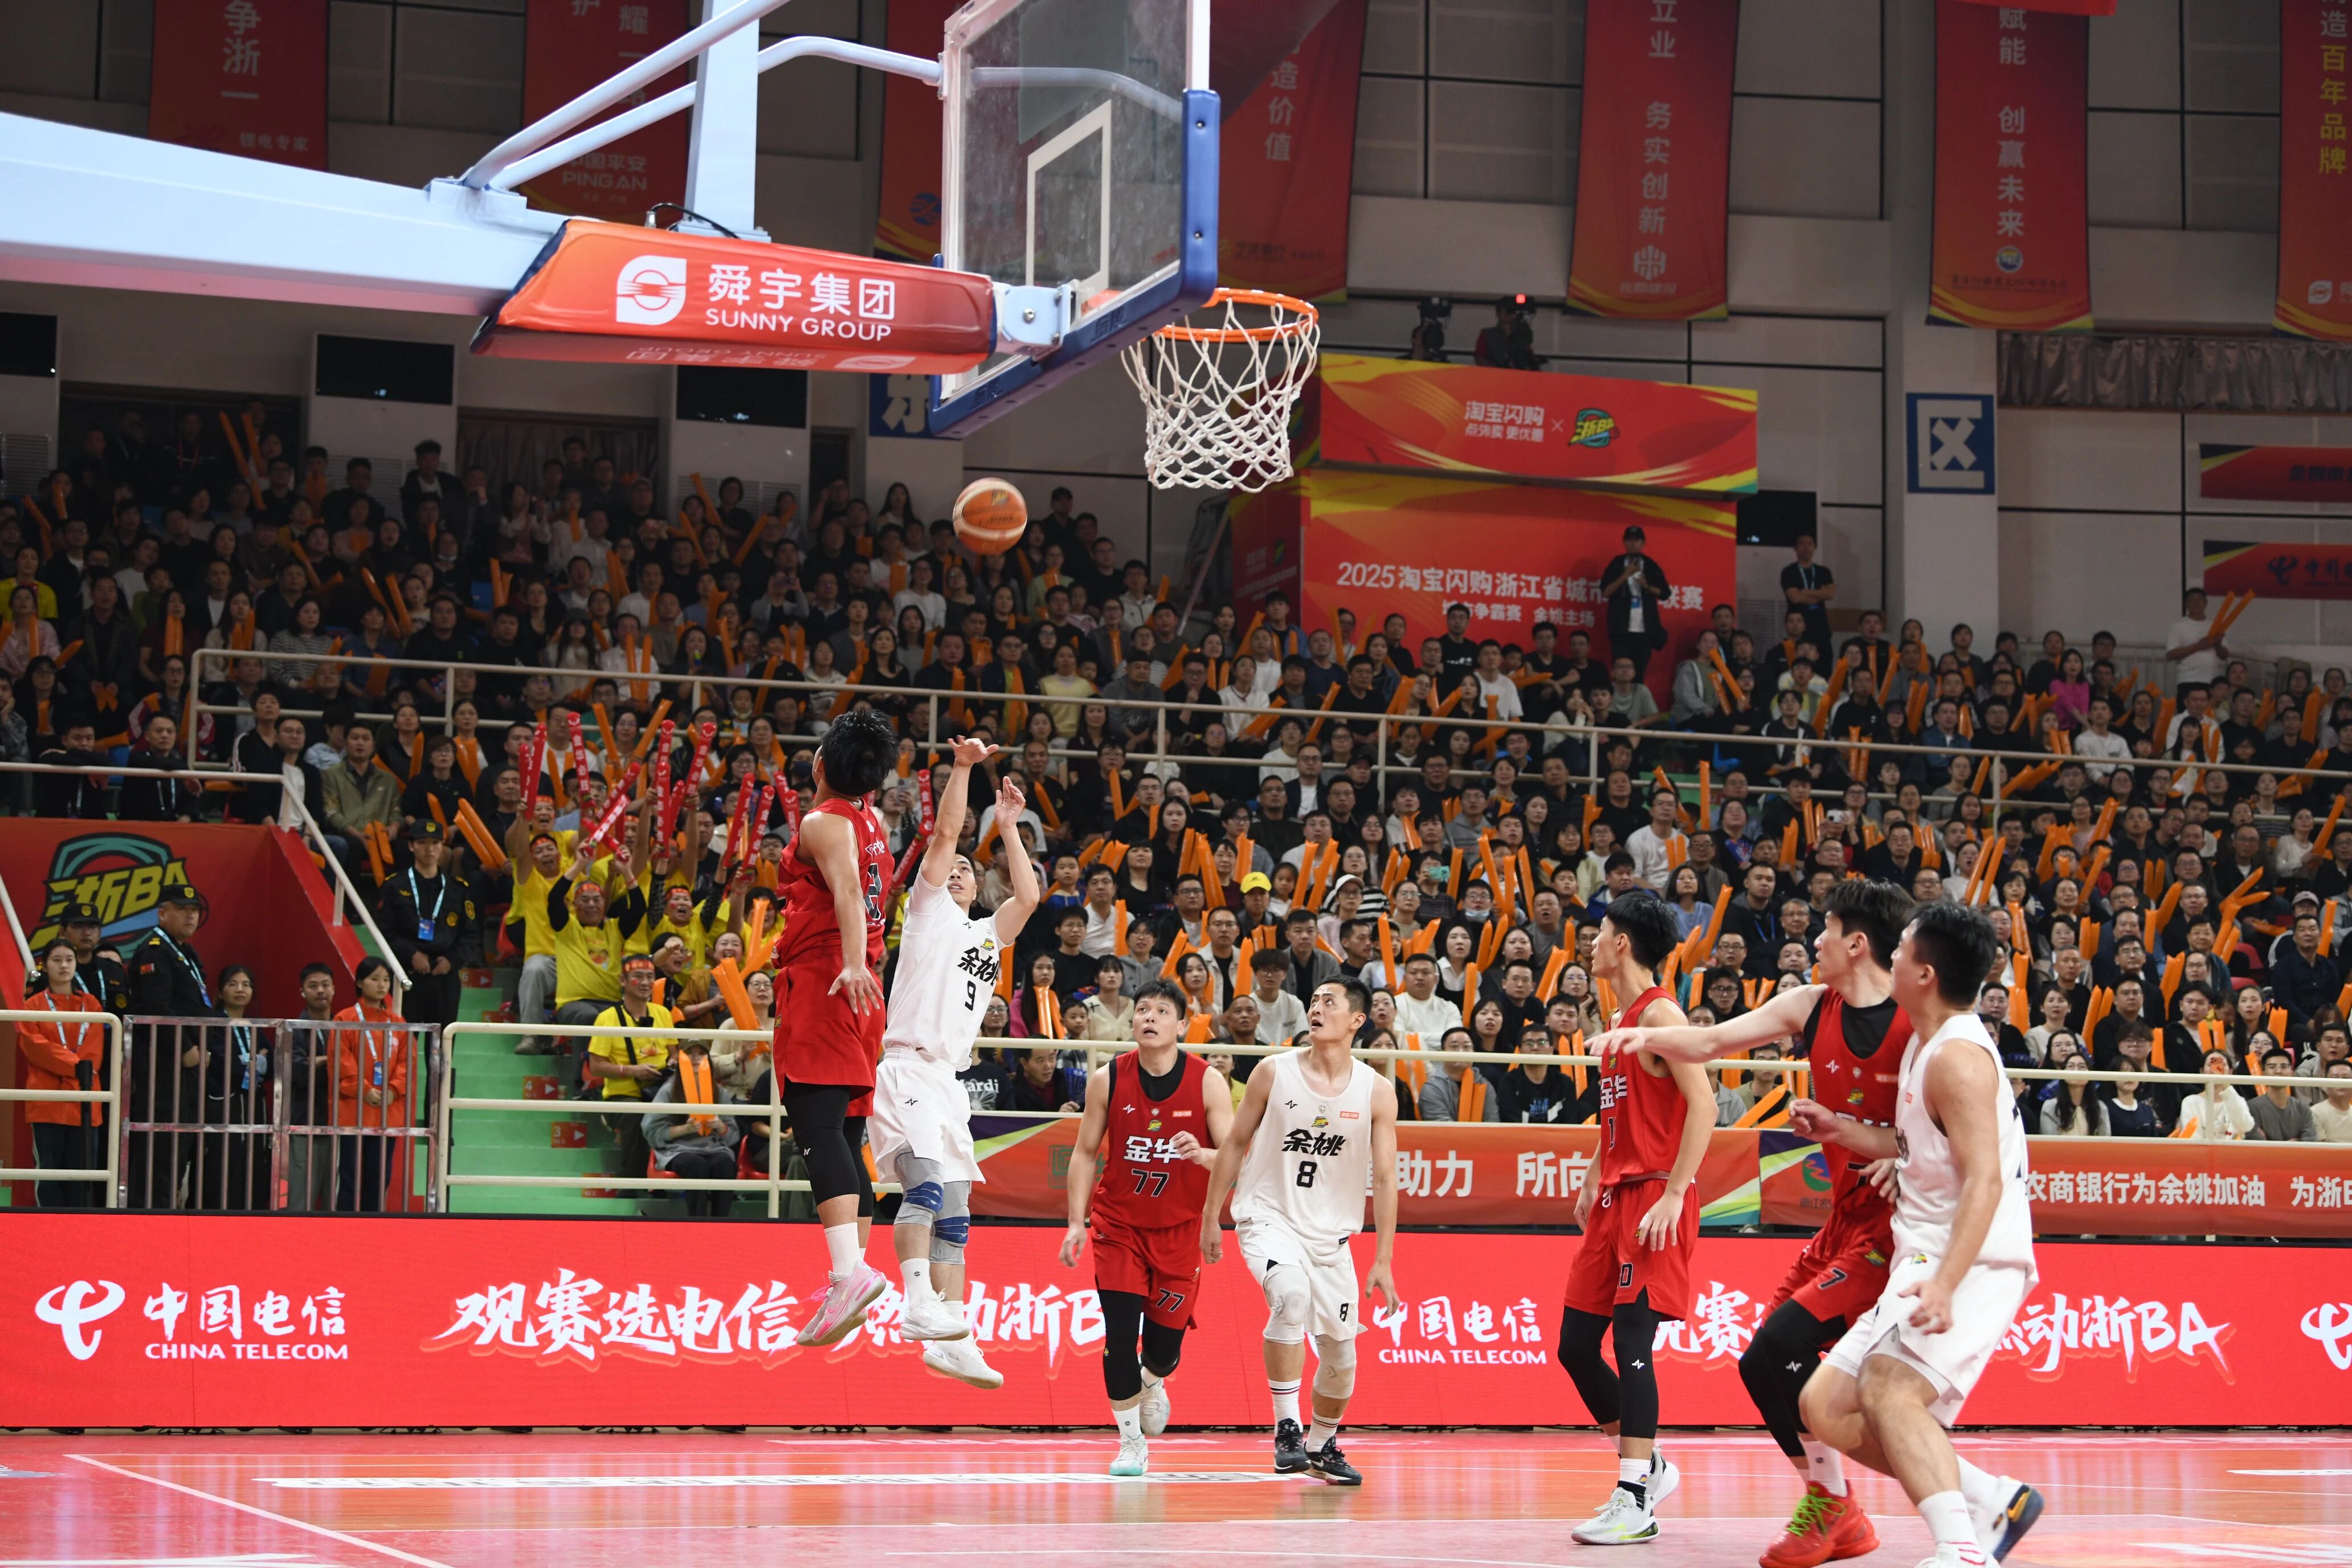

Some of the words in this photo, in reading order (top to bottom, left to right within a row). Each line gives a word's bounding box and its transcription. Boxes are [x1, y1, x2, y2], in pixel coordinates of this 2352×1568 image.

[1648, 0, 1677, 58] 立业
[1999, 8, 2027, 66] 赋能
[1265, 43, 1301, 163] 造价值
[2319, 0, 2347, 175] 造百年品牌
[1638, 101, 1672, 235] 务实创新
[1997, 105, 2026, 238] 创赢未来
[708, 264, 895, 320] 舜宇集团
[705, 308, 794, 333] SUNNY
[801, 316, 892, 342] GROUP
[1464, 401, 1545, 426] 淘宝闪购
[1916, 399, 1985, 489] 区
[1337, 561, 1704, 611] 2025淘宝闪购浙江省城市联赛
[957, 946, 999, 986] 余姚
[965, 980, 976, 1011] 9
[1600, 1073, 1627, 1109] 金华
[1124, 1136, 1183, 1163] 金华
[1281, 1128, 1346, 1156] 余姚
[1132, 1168, 1170, 1197] 77
[1296, 1160, 1317, 1188] 8
[1366, 1149, 1473, 1198] 助力
[2025, 1170, 2265, 1207] 农商银行为余姚加油
[1799, 1197, 1833, 1209] 浙江农
[1619, 1262, 1634, 1288] 0
[1818, 1267, 1848, 1291] 7
[144, 1282, 346, 1341] 中国电信
[432, 1268, 799, 1362] 观赛选电信
[1155, 1288, 1186, 1313] 77
[1339, 1302, 1350, 1322] 8
[1372, 1296, 1542, 1348] 中国电信
[145, 1343, 226, 1359] CHINA
[233, 1344, 348, 1360] TELECOM
[1379, 1349, 1444, 1364] CHINA
[1449, 1349, 1547, 1365] TELECOM
